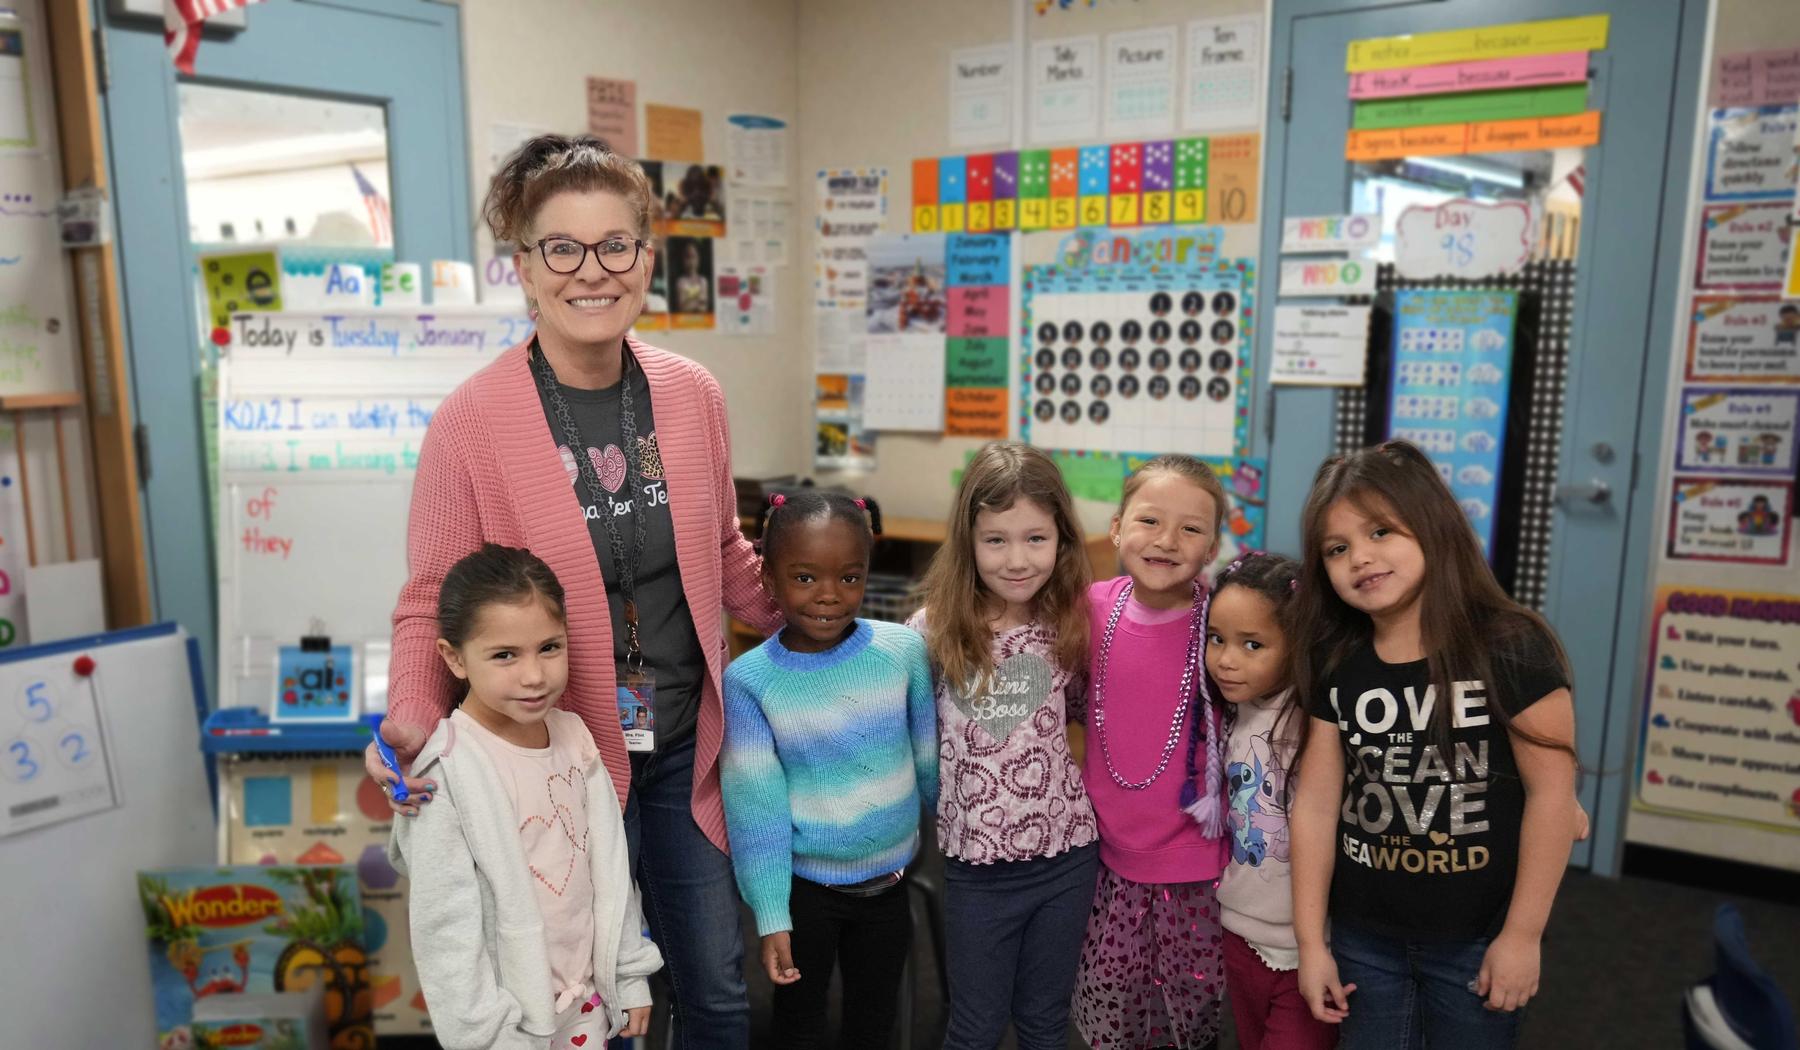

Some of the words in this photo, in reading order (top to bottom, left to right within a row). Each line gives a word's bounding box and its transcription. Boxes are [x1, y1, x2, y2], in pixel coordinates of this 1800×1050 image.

[918, 207, 933, 230] 0
[973, 204, 987, 229] 2
[997, 202, 1008, 227] 3
[1025, 202, 1041, 225] 4
[1055, 202, 1069, 225] 5
[1085, 199, 1100, 223] 6
[1114, 199, 1130, 221] 7
[1150, 193, 1163, 218] 8
[1182, 192, 1196, 217] 9
[1220, 187, 1246, 222] 10
[1435, 206, 1471, 229] Day
[1441, 232, 1473, 267] 98
[326, 264, 360, 294] Aa
[382, 262, 415, 292] Ee
[233, 314, 297, 355] Today
[308, 323, 324, 346] is
[416, 314, 486, 351] January
[288, 397, 303, 430] I
[246, 486, 277, 521] of
[242, 527, 293, 560] they
[299, 656, 335, 691] ai
[26, 682, 53, 723] 5
[971, 695, 1028, 721] Boss
[1330, 680, 1490, 734] LOVE
[60, 733, 90, 763] 2
[1387, 732, 1414, 744] THE
[9, 741, 39, 781] 3
[1342, 782, 1490, 835] LOVE
[1343, 832, 1490, 873] SEAWORLD
[1380, 834, 1411, 846] THE
[163, 884, 285, 928] Wonders
